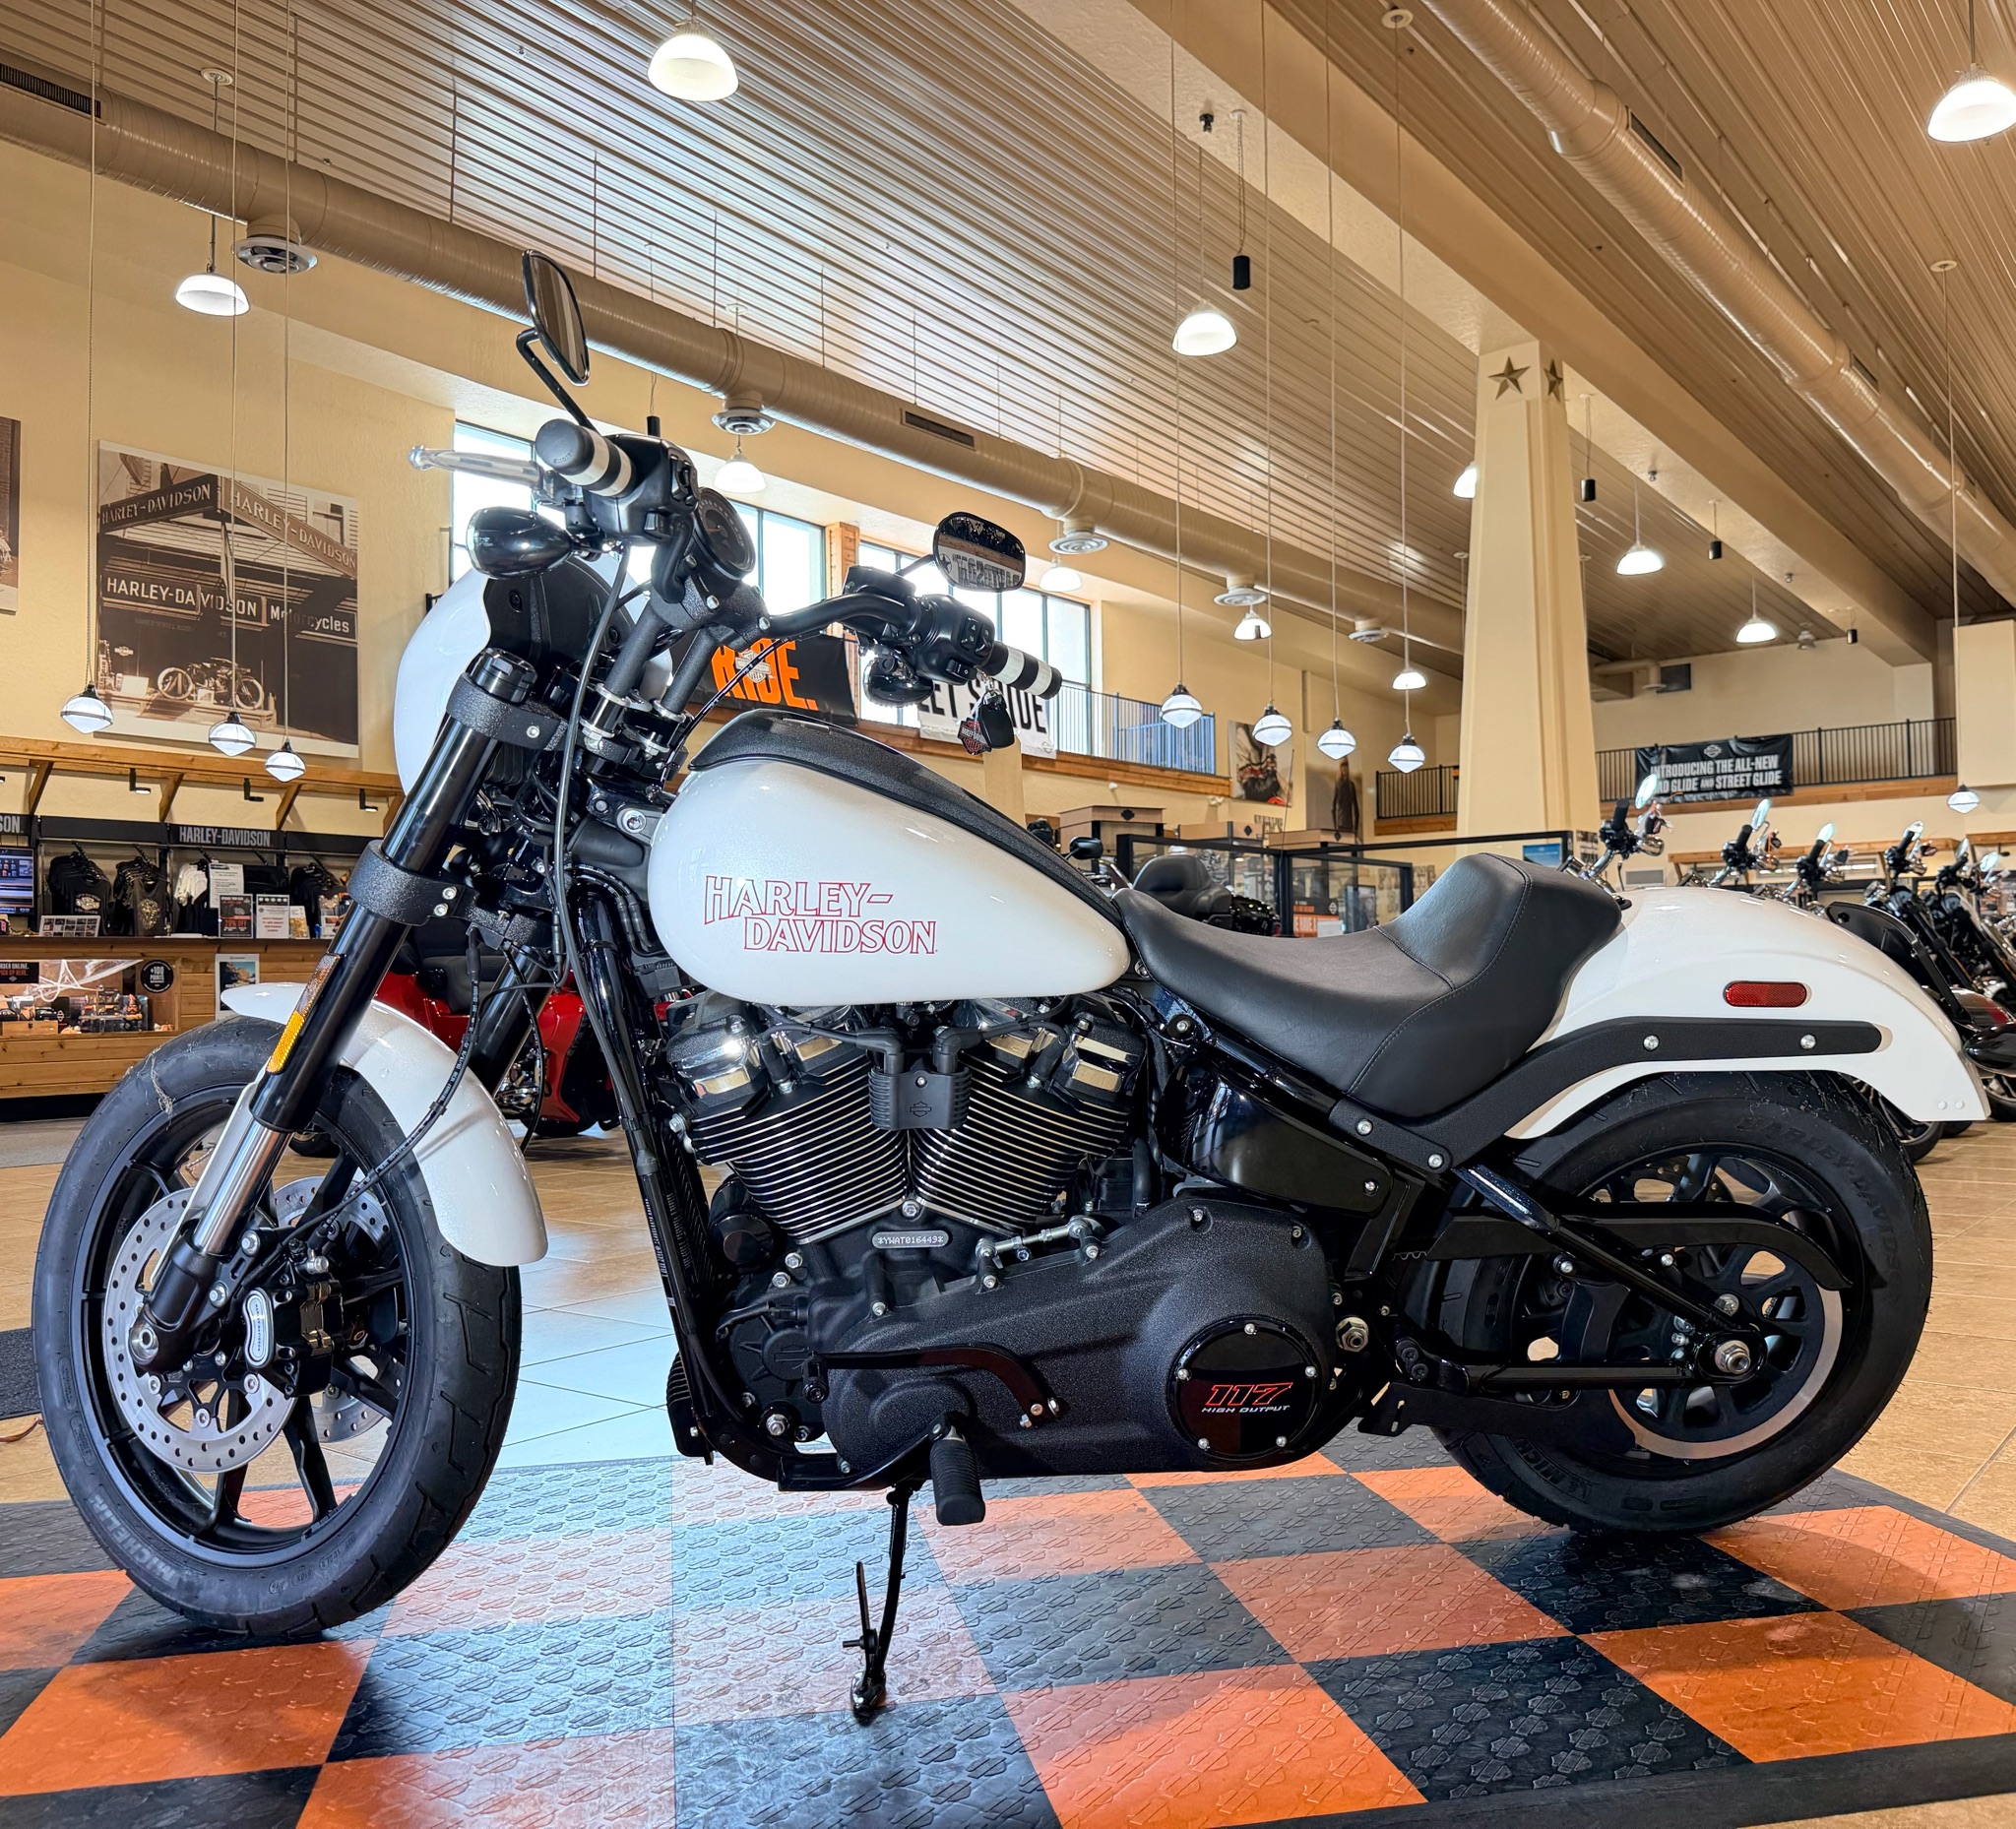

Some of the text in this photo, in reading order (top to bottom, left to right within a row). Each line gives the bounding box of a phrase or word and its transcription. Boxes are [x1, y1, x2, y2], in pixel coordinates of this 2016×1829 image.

[101, 483, 212, 525] HARLEY-DAVIDSON
[229, 491, 356, 569] HARLEY-DAVIDSON
[1650, 754, 1779, 779] INTRODUCING THE ALL-NEW
[1656, 780, 1670, 794] AD
[1670, 778, 1698, 791] GLIDE
[1715, 773, 1752, 789] STREET
[1752, 770, 1782, 787] GLIDE
[179, 826, 271, 847] HARLEY-DAVIDSON
[704, 875, 893, 924] HARLEY-
[744, 916, 936, 954] DAVIDSON
[1205, 1382, 1293, 1407] 117
[1238, 1405, 1291, 1414] OUTPUT
